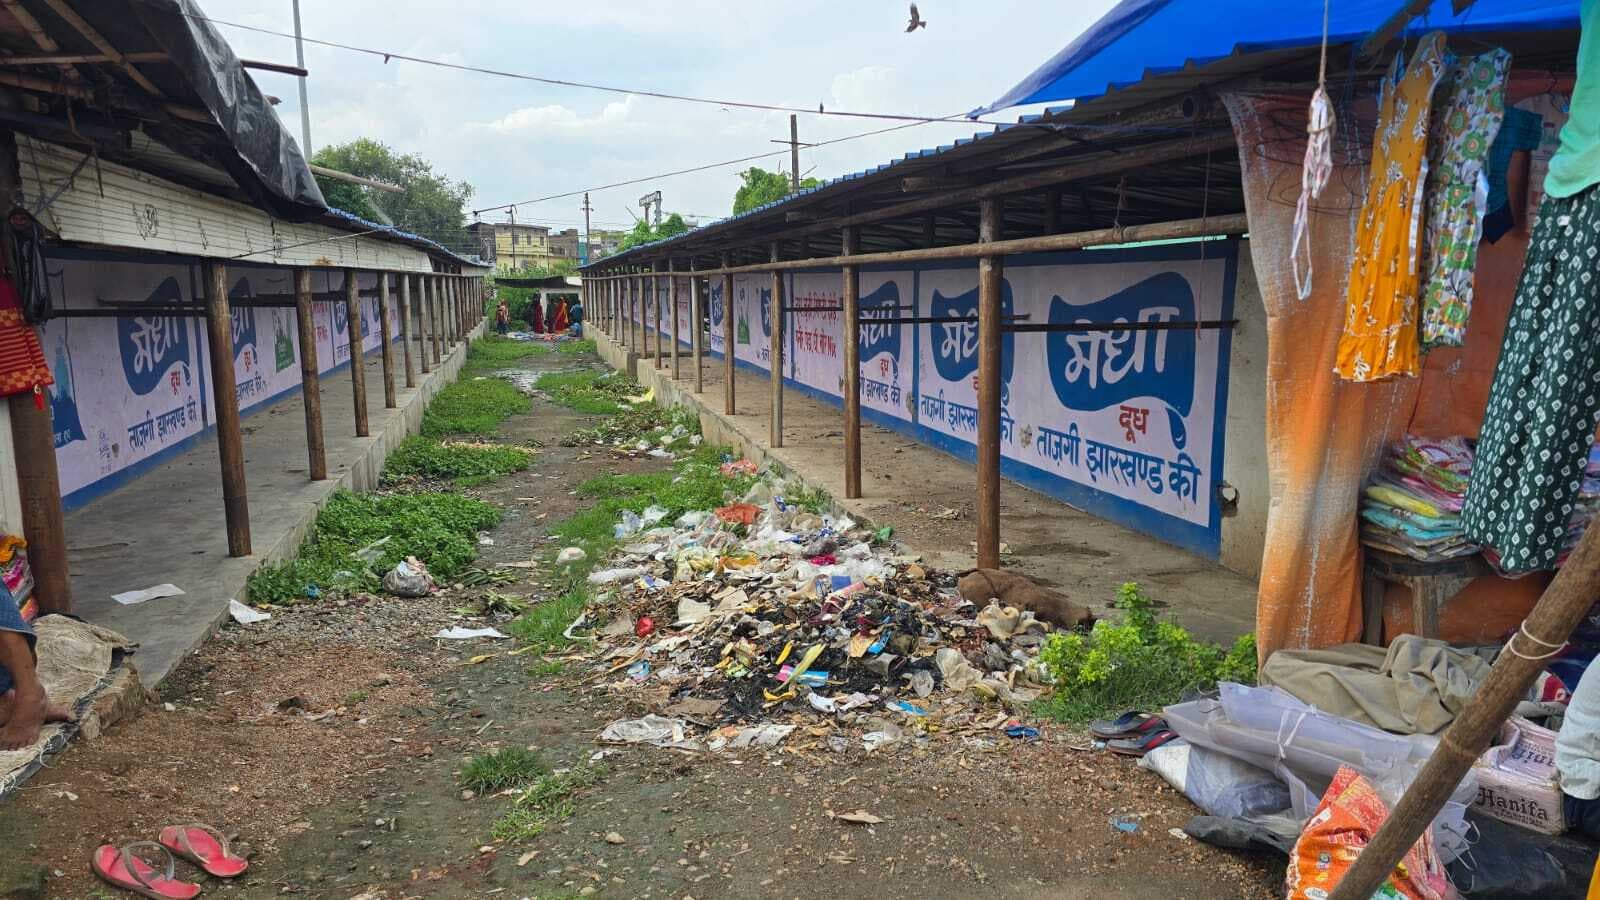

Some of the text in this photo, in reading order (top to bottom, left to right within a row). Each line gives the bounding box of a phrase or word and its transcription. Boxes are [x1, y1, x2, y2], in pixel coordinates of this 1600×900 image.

[1119, 405, 1149, 443] दूध
[1085, 439, 1165, 495] झारखण्ड
[1168, 453, 1202, 504] की
[1476, 787, 1549, 820] Hanifa
